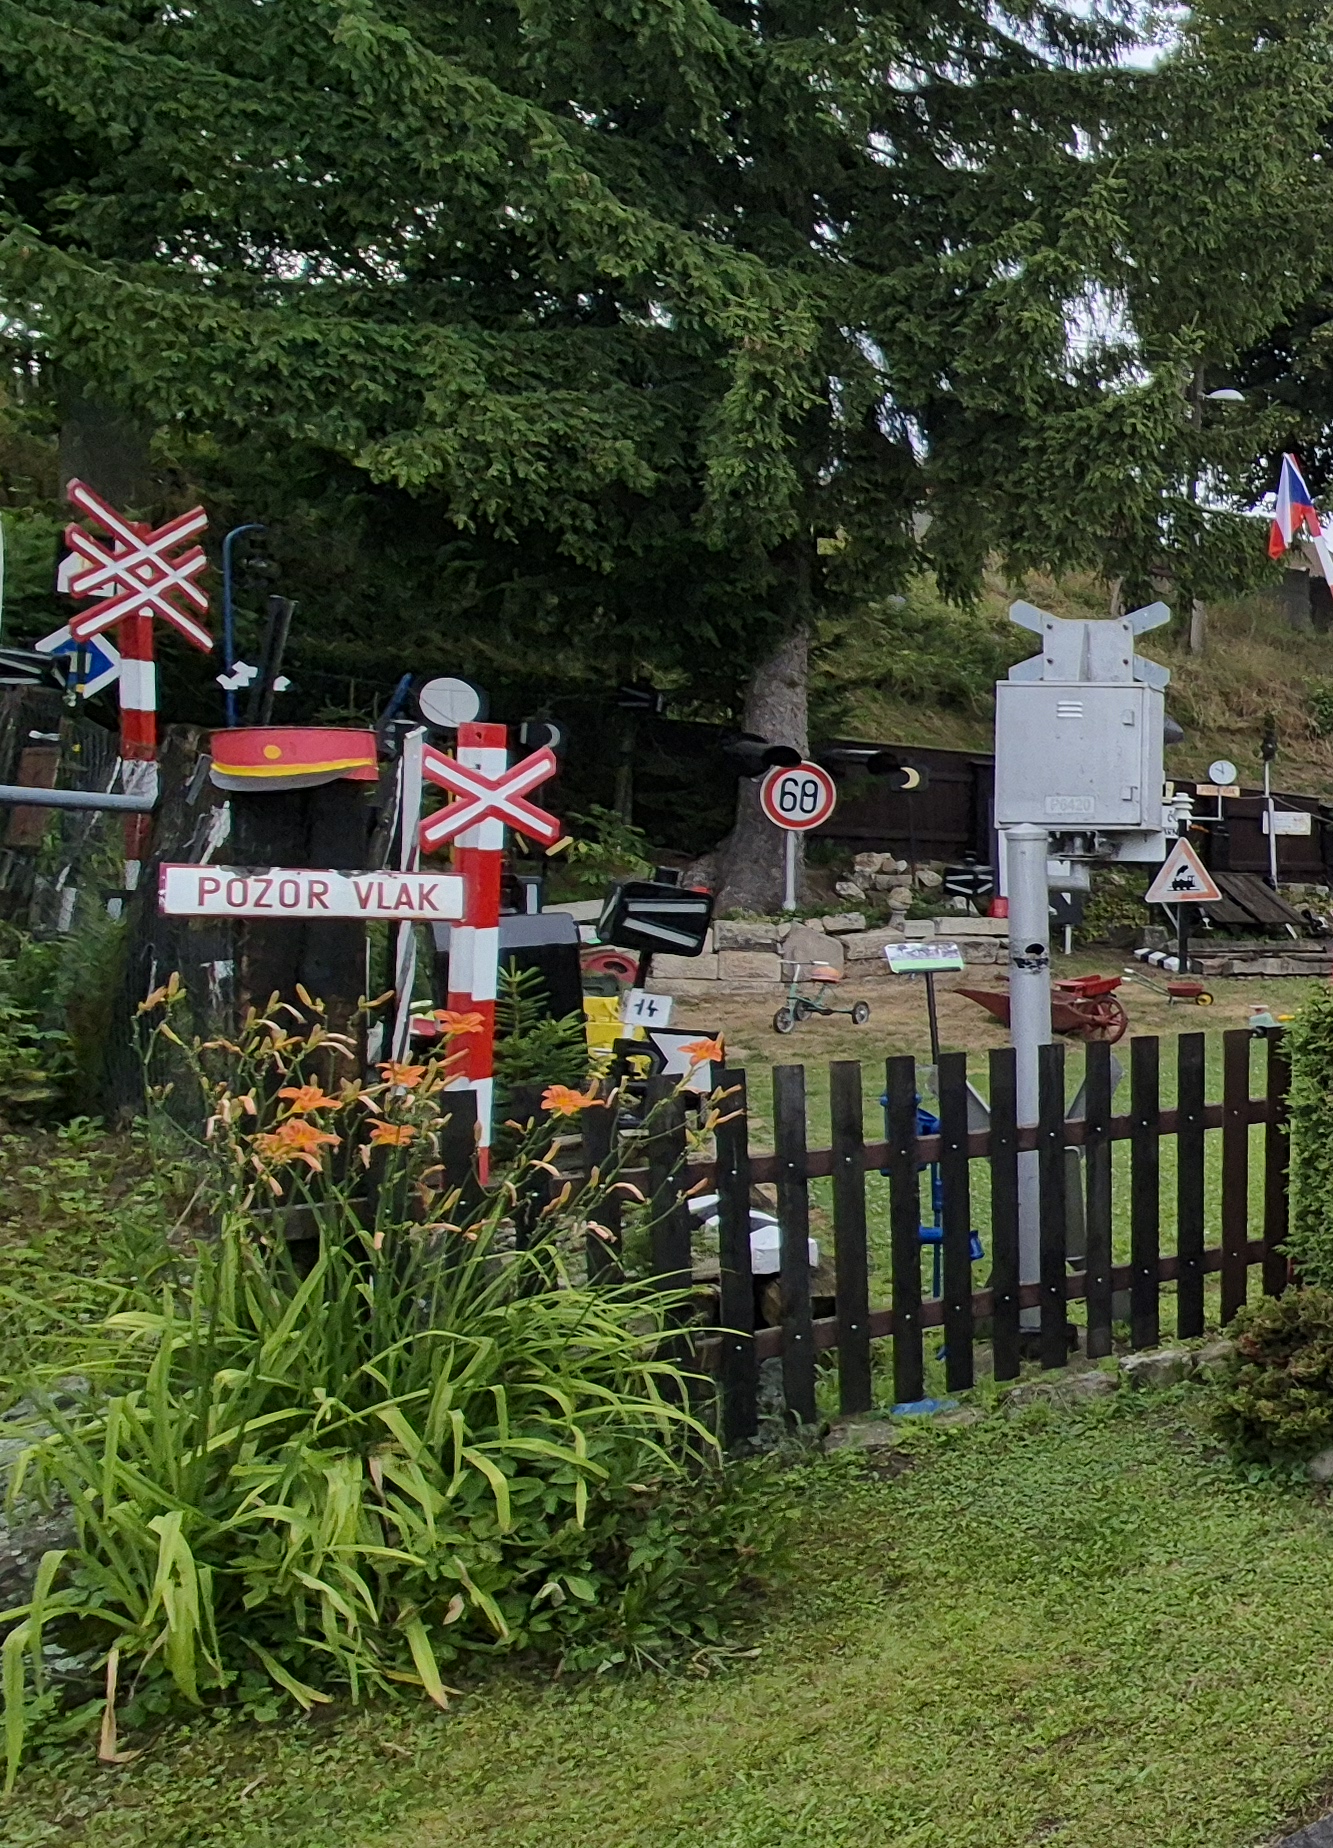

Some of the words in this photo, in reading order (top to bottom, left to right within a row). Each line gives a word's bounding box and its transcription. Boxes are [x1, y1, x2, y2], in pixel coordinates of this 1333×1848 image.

[779, 777, 819, 814] 68
[198, 876, 330, 911] POZOR
[352, 881, 440, 912] VLAK
[634, 998, 659, 1018] 14
